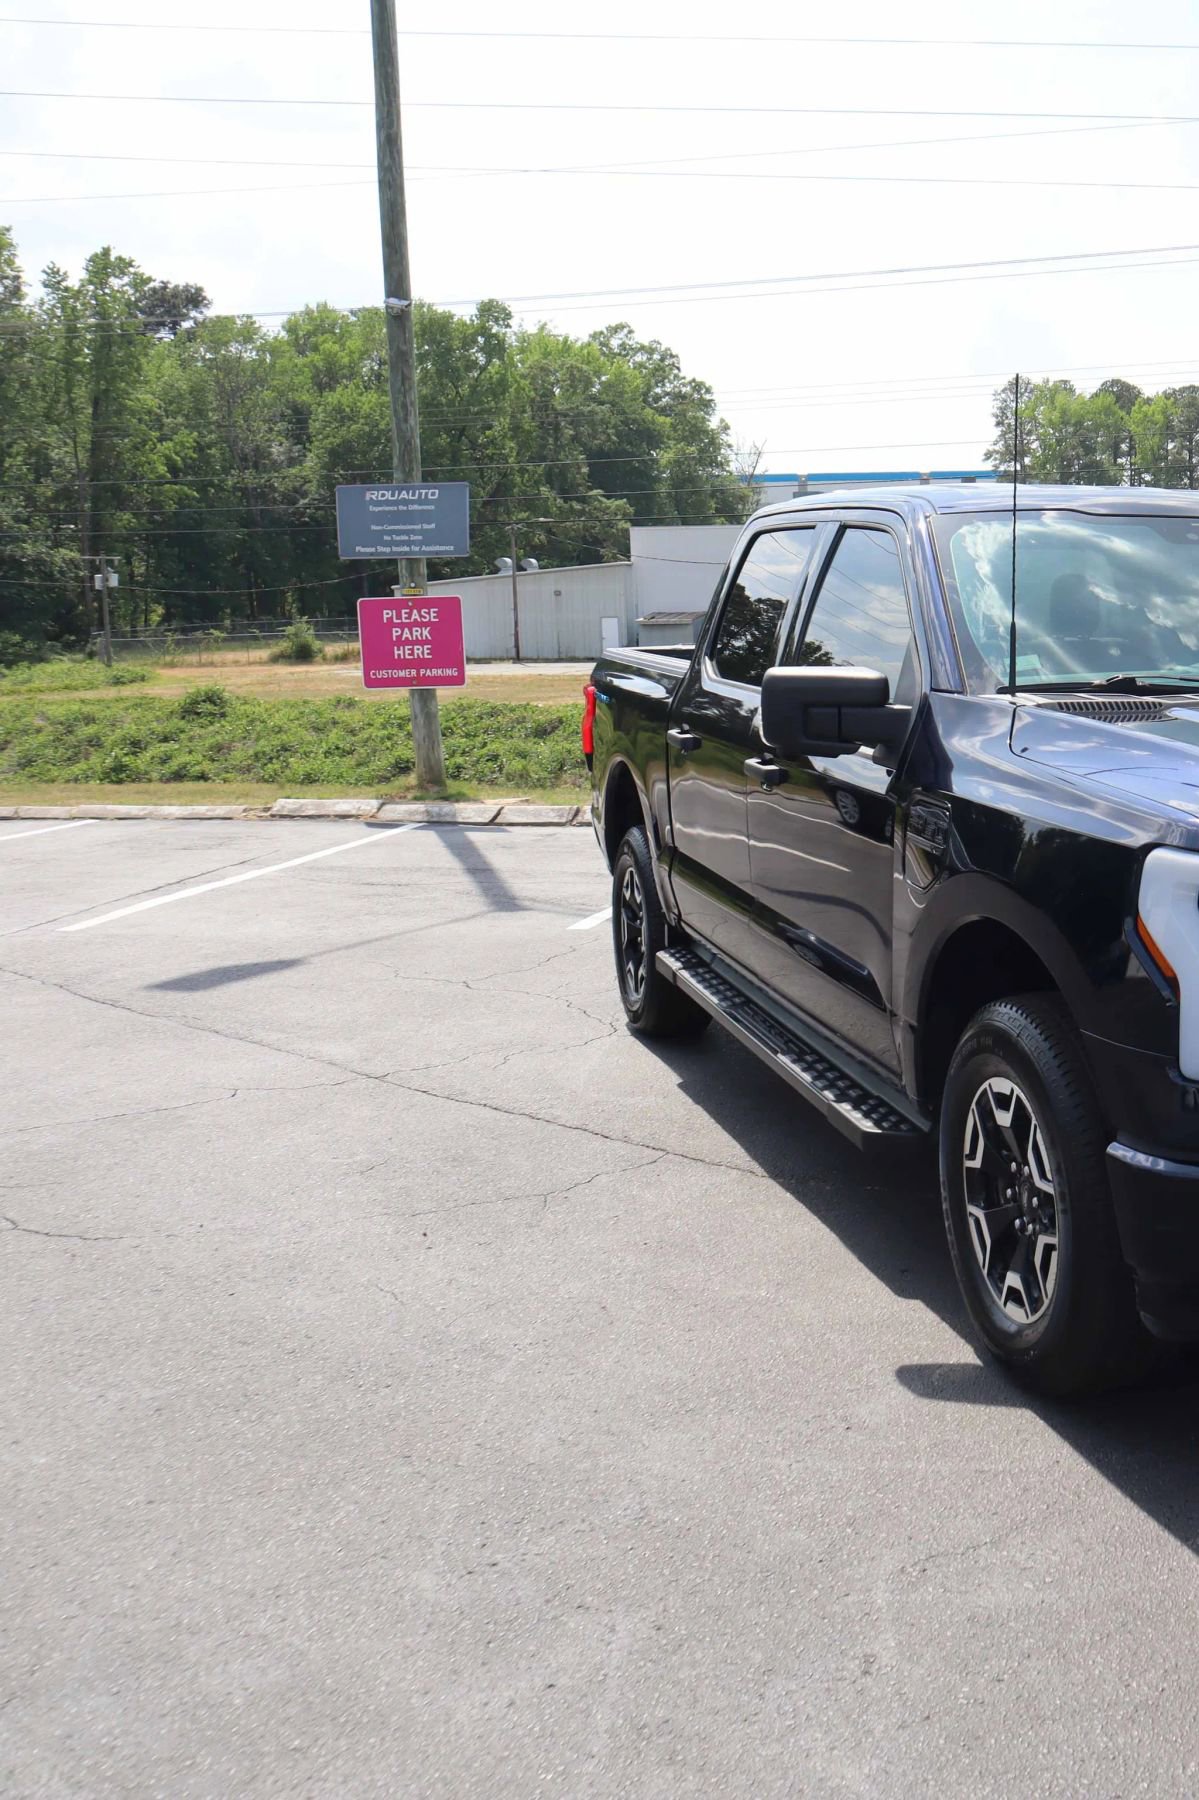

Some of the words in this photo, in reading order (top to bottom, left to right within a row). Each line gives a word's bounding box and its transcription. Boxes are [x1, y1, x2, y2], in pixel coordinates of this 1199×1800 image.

[377, 545, 391, 553] Step
[383, 608, 439, 623] PLEASE
[392, 626, 432, 641] PARK
[394, 645, 433, 659] HERE
[370, 669, 417, 679] CUSTOMER
[420, 668, 458, 677] PARKING
